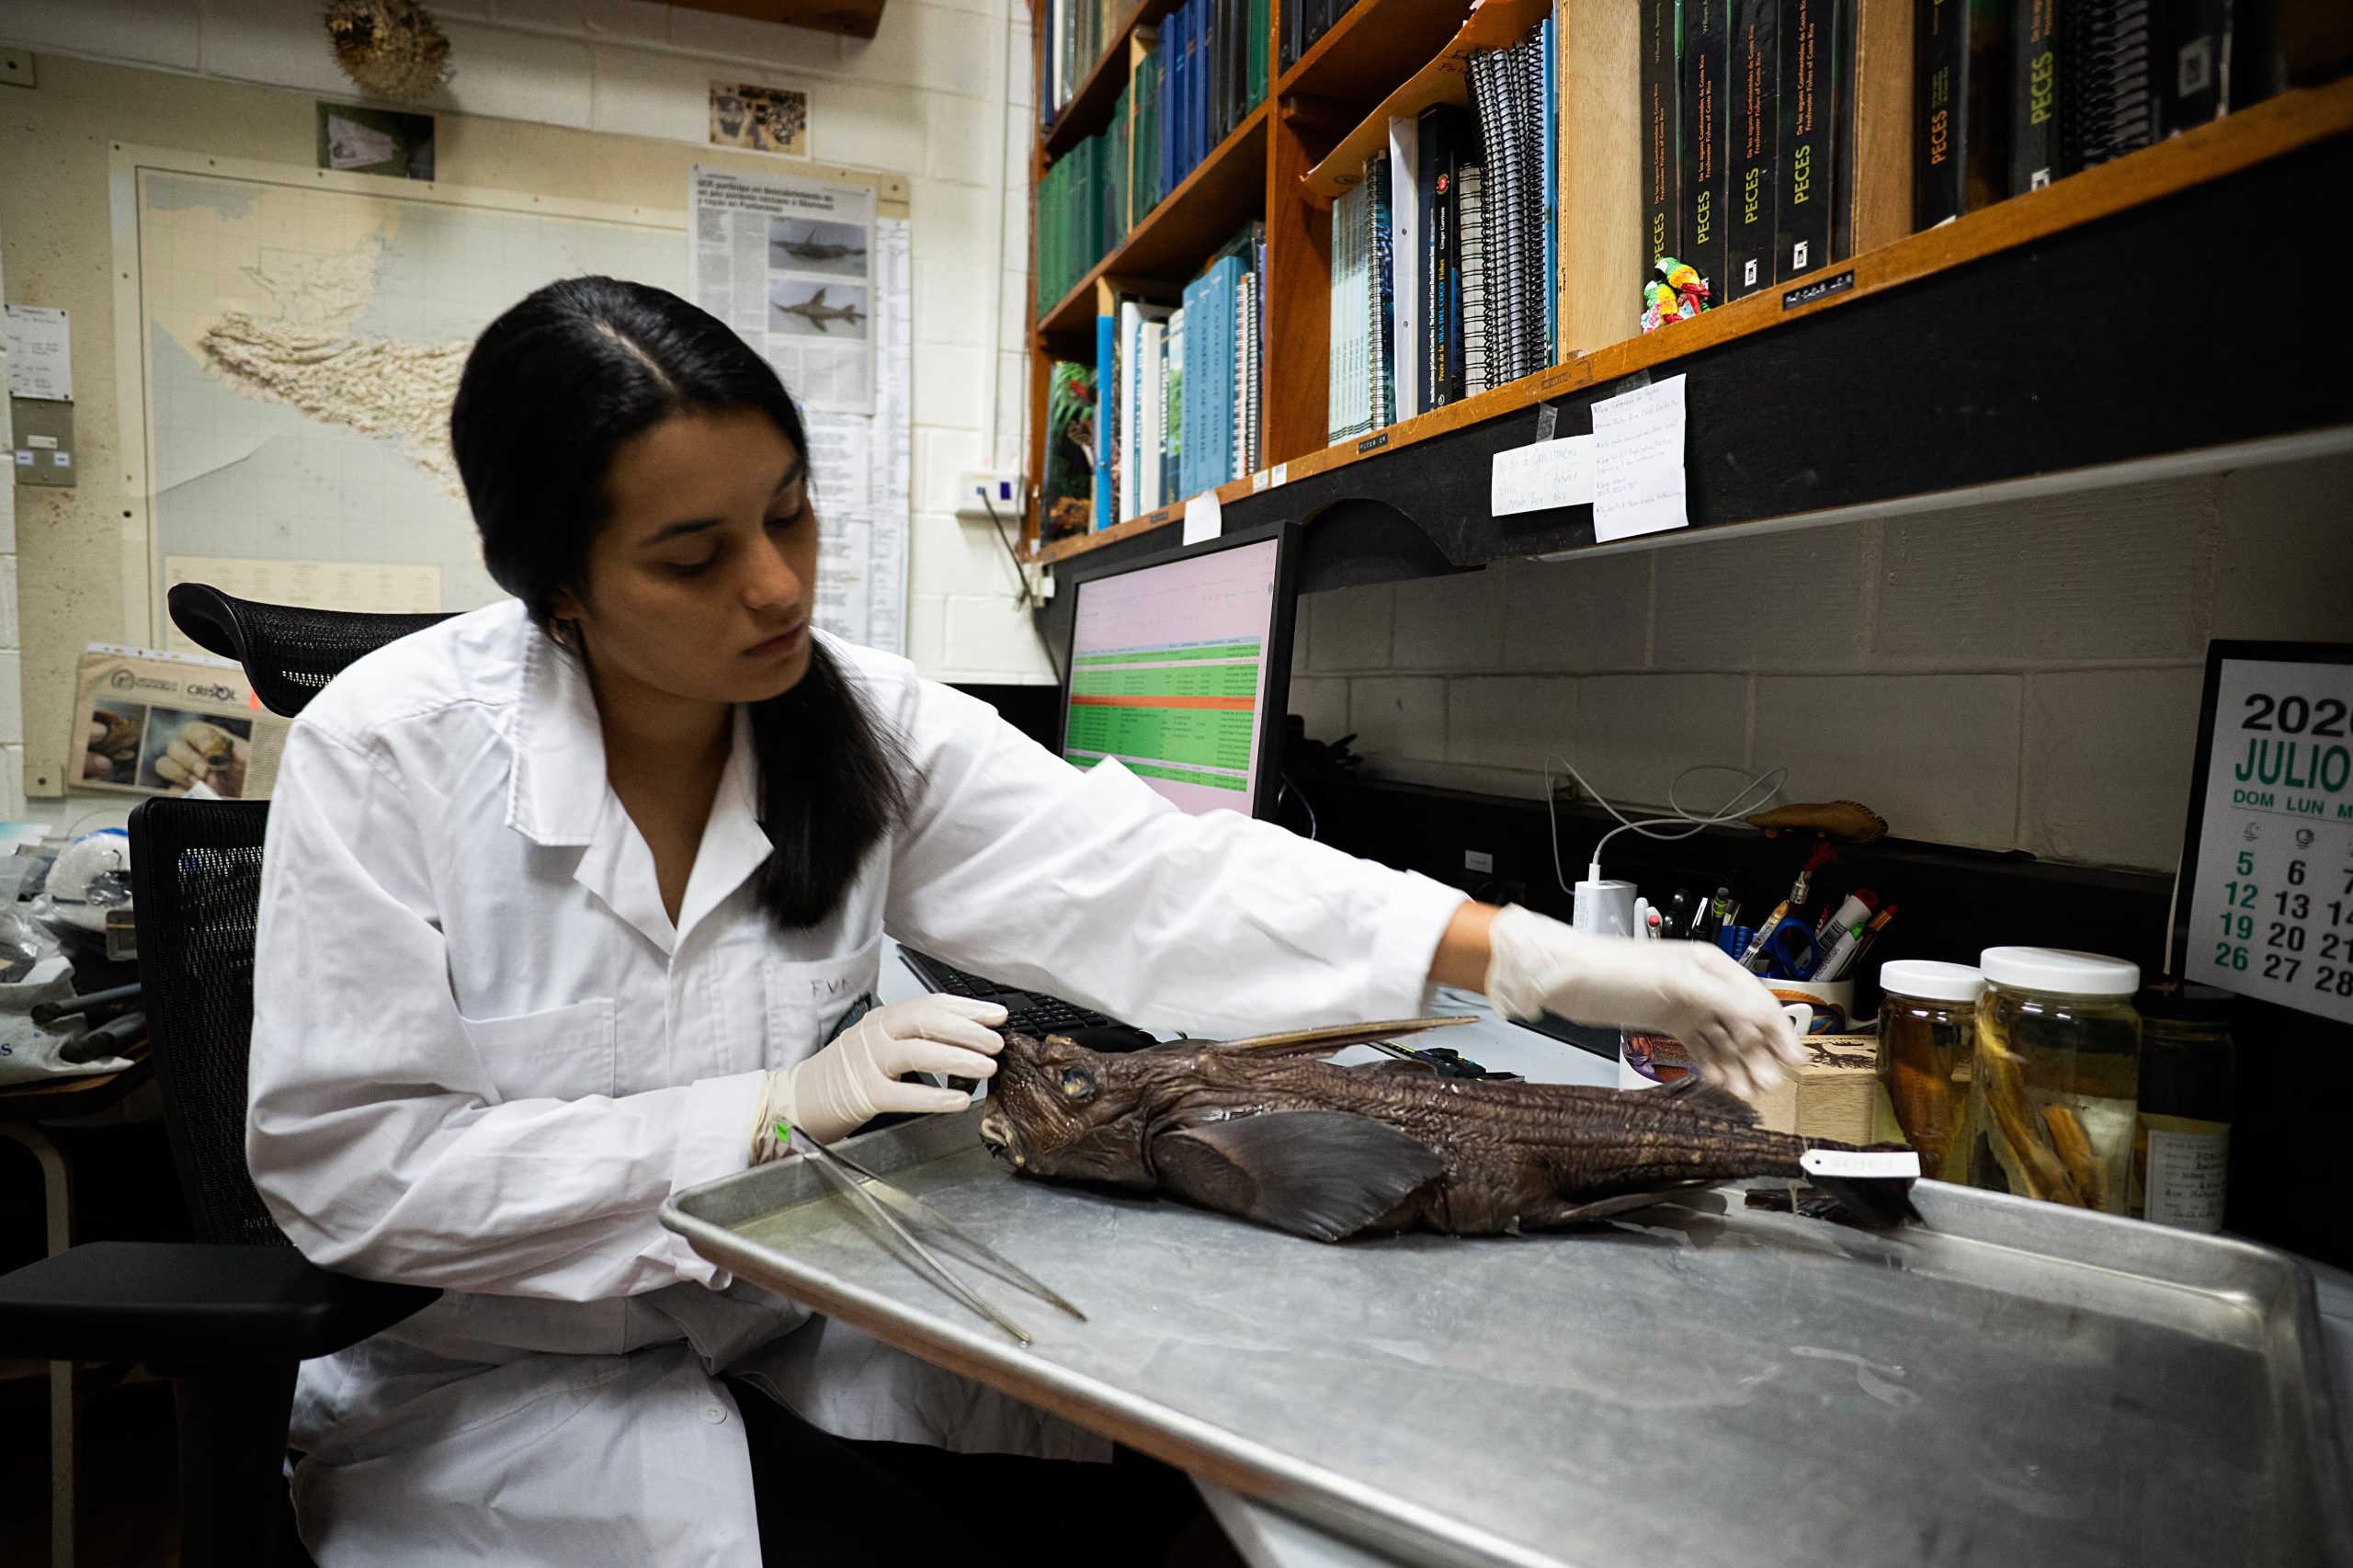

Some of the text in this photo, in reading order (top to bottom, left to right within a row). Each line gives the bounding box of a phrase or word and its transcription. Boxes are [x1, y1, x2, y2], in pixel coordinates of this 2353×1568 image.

[1799, 32, 1806, 41] de
[1748, 61, 1754, 69] de
[2030, 51, 2054, 125] PECES
[1797, 125, 1803, 135] De
[1931, 109, 1948, 165] PECES
[1746, 149, 1753, 158] De
[1794, 145, 1811, 204] PECES
[1699, 173, 1705, 182] De
[1745, 167, 1759, 224] PECES
[1654, 212, 1665, 263] PECES
[1698, 190, 1711, 244] PECES
[1438, 354, 1445, 362] de
[2234, 738, 2350, 793] JULIO
[2234, 789, 2274, 808] DOM
[2286, 796, 2325, 815] LUN
[2236, 851, 2255, 876] 5
[2288, 860, 2307, 886] 6
[2224, 881, 2258, 910] 12
[2274, 891, 2310, 920] 13
[2220, 912, 2353, 964] 19 20 21
[2214, 941, 2353, 998] 26 27 28
